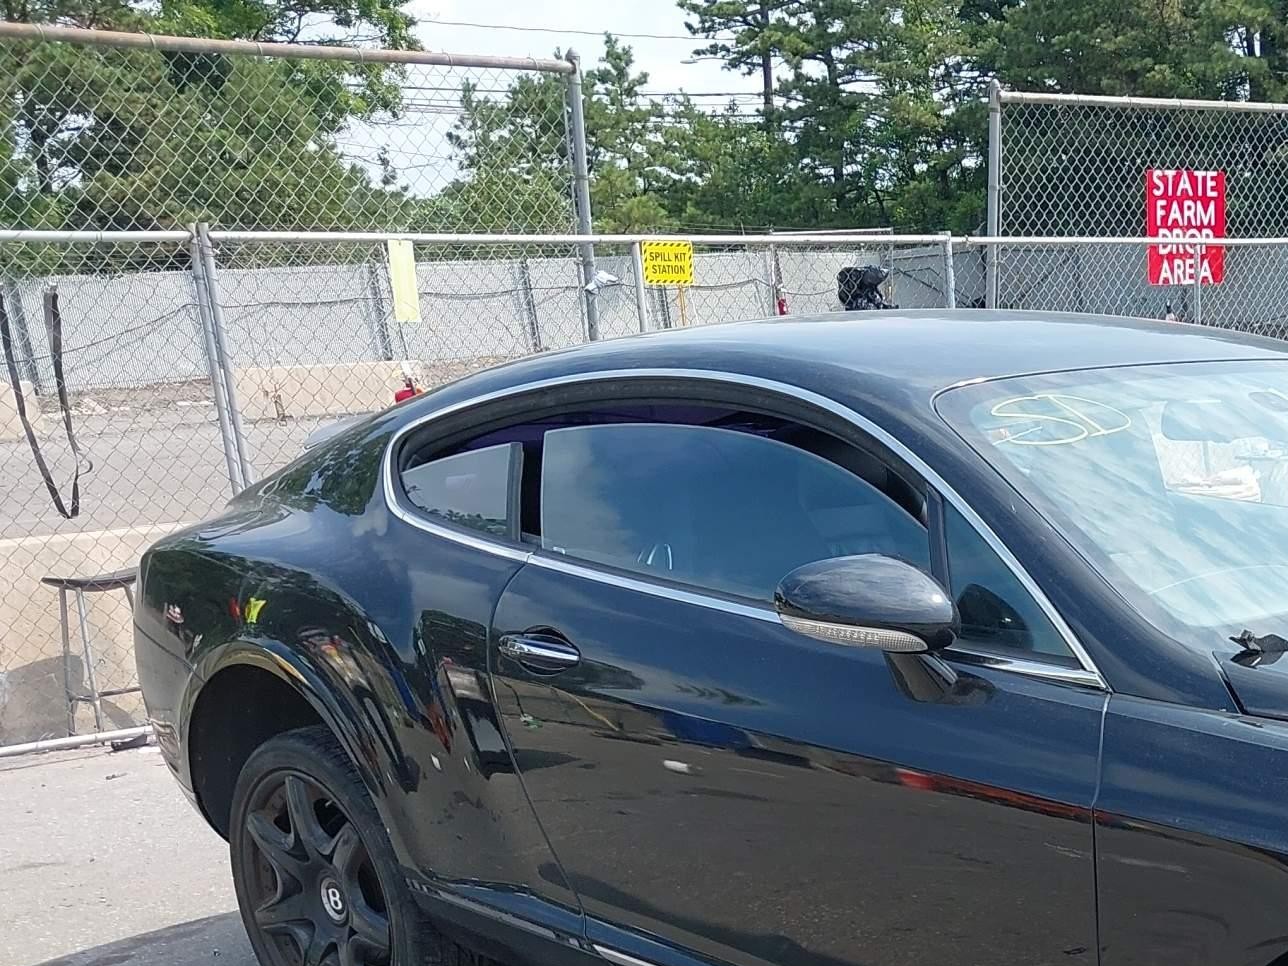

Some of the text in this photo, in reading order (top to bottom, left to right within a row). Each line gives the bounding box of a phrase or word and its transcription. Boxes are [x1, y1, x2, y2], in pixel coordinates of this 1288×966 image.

[1153, 170, 1218, 197] STATE
[1156, 199, 1216, 227] FARM
[1158, 228, 1214, 255] DROP
[649, 252, 687, 263] SPILL KIT
[652, 265, 686, 275] STATION
[1158, 258, 1214, 285] AREA
